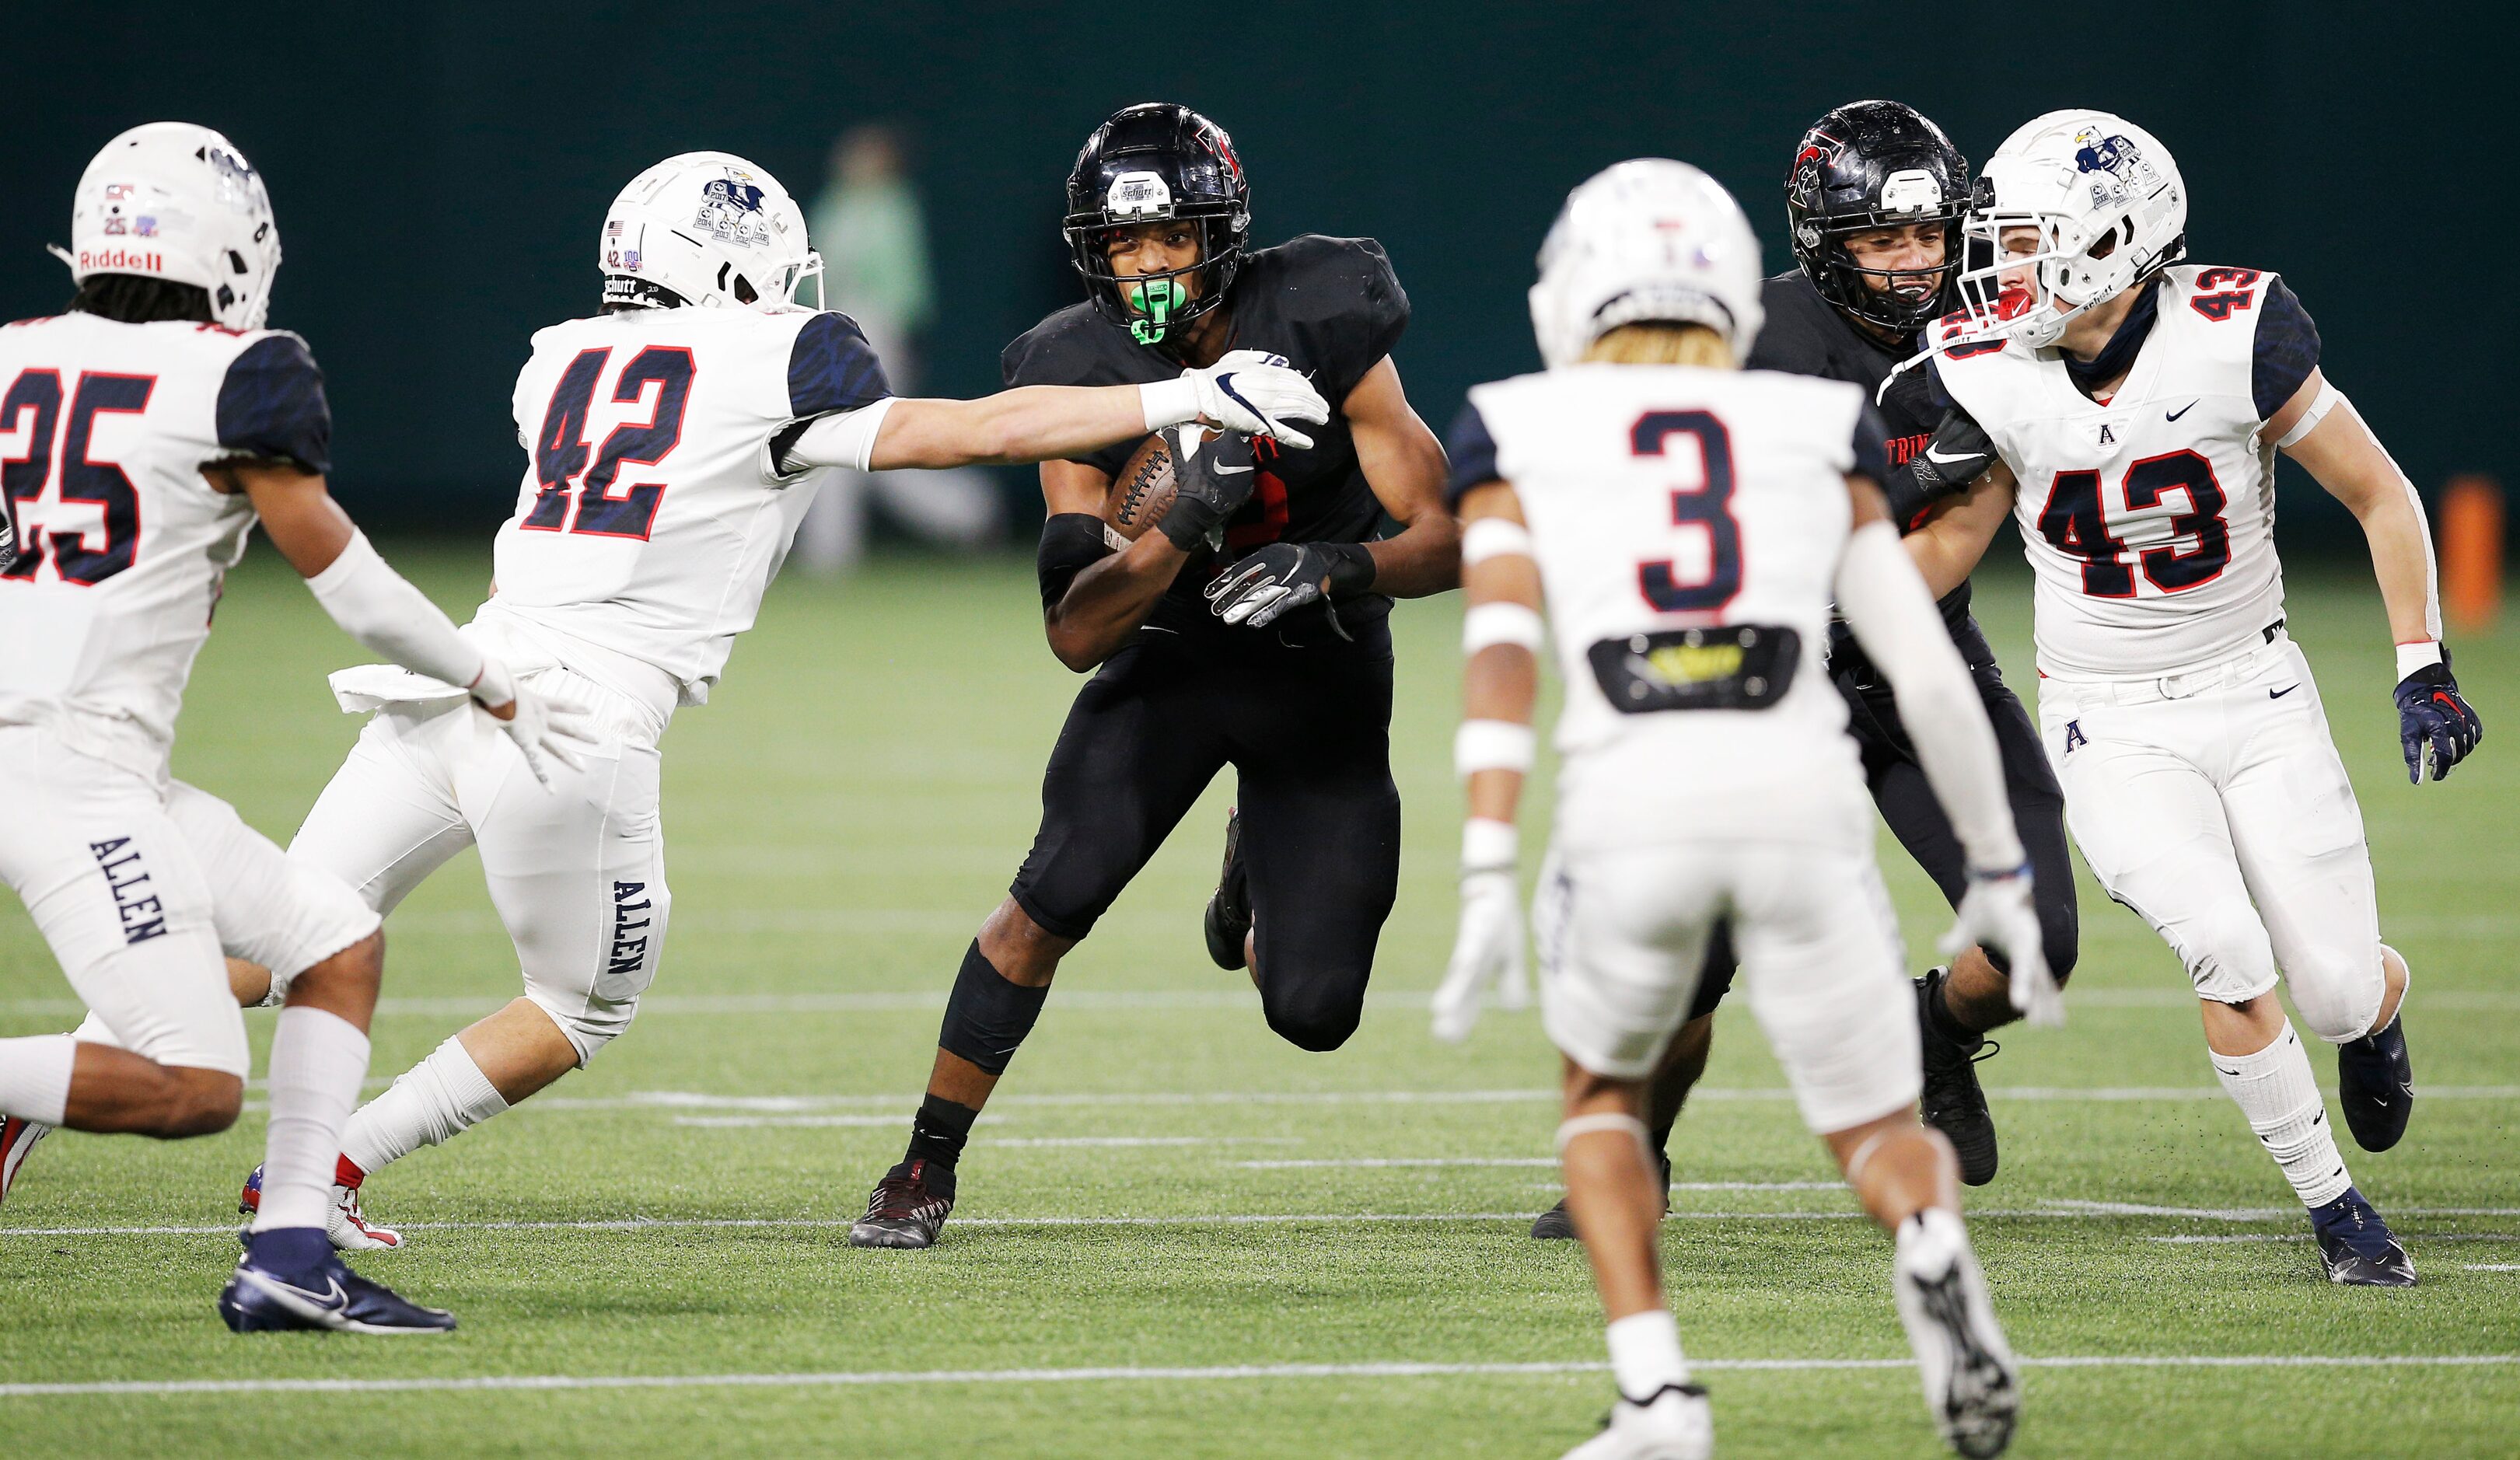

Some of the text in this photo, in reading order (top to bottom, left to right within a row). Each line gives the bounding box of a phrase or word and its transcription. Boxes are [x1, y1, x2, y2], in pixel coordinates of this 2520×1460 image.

[710, 192, 727, 201] 2017
[2094, 194, 2109, 204] 2008
[697, 218, 711, 227] 2014
[715, 230, 729, 239] 2013
[735, 235, 749, 245] 2012
[80, 249, 163, 272] Riddell
[607, 250, 620, 267] 42
[624, 250, 638, 262] 100
[604, 275, 637, 294] schutt
[519, 344, 697, 543] 42
[2099, 422, 2116, 446] A
[1883, 432, 1935, 466] TRIN
[0, 368, 159, 588] 25
[1629, 410, 1744, 613] 3
[2036, 448, 2232, 598] 43
[2063, 716, 2089, 756] A
[89, 837, 167, 945] ALLEN
[607, 881, 652, 974] ALLEN
